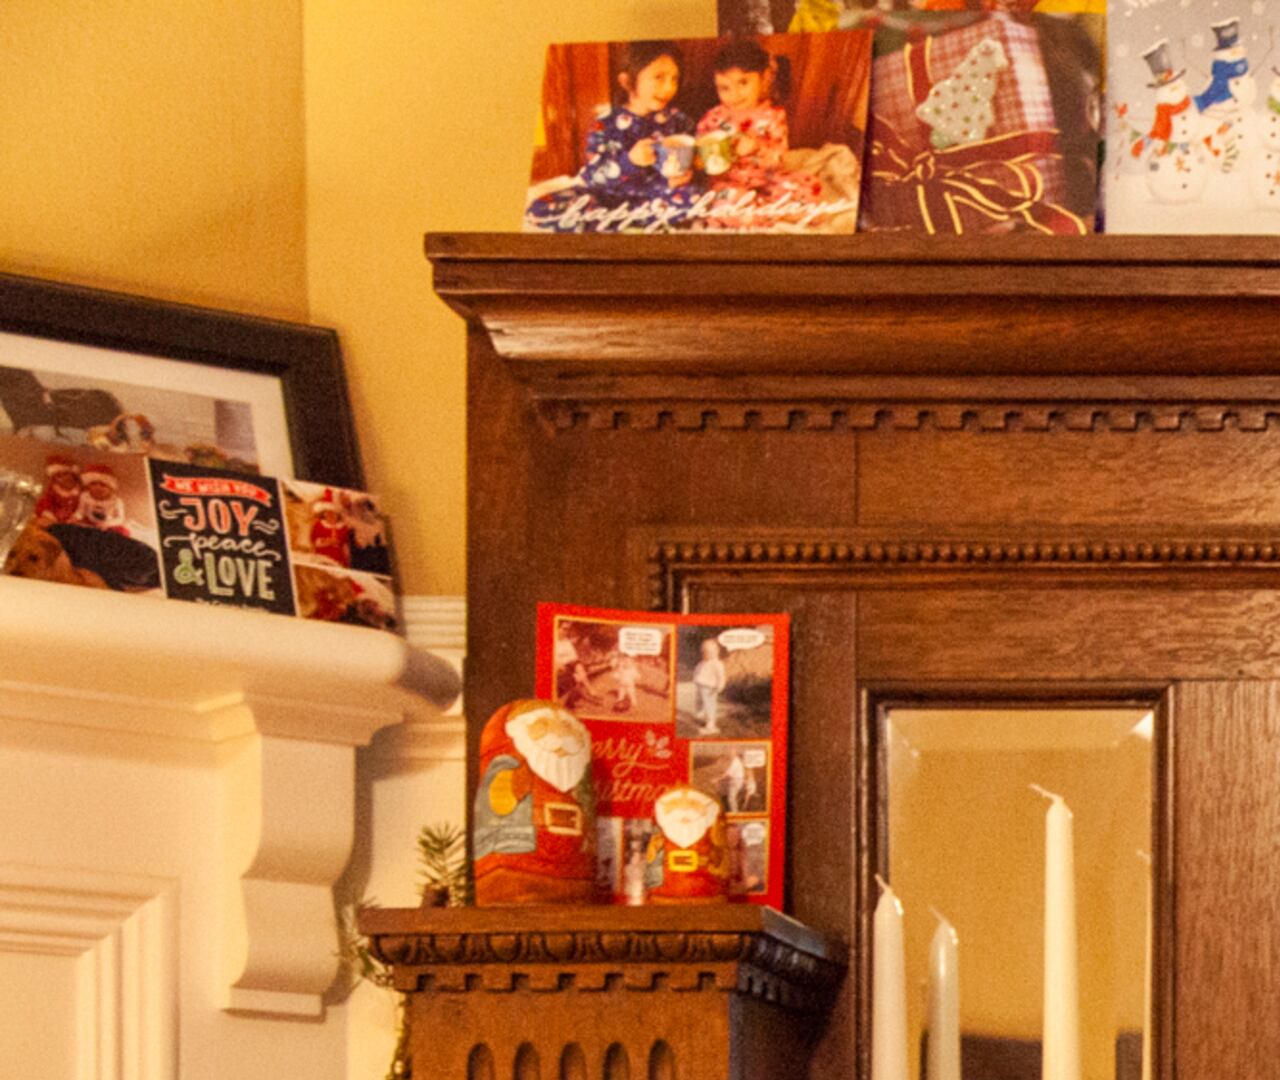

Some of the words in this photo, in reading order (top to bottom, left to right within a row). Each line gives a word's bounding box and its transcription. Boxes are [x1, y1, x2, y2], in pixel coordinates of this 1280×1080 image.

[684, 189, 858, 230] holidays
[180, 497, 258, 536] JOY
[164, 533, 281, 560] peace
[174, 548, 204, 586] &
[204, 552, 276, 600] LOVE
